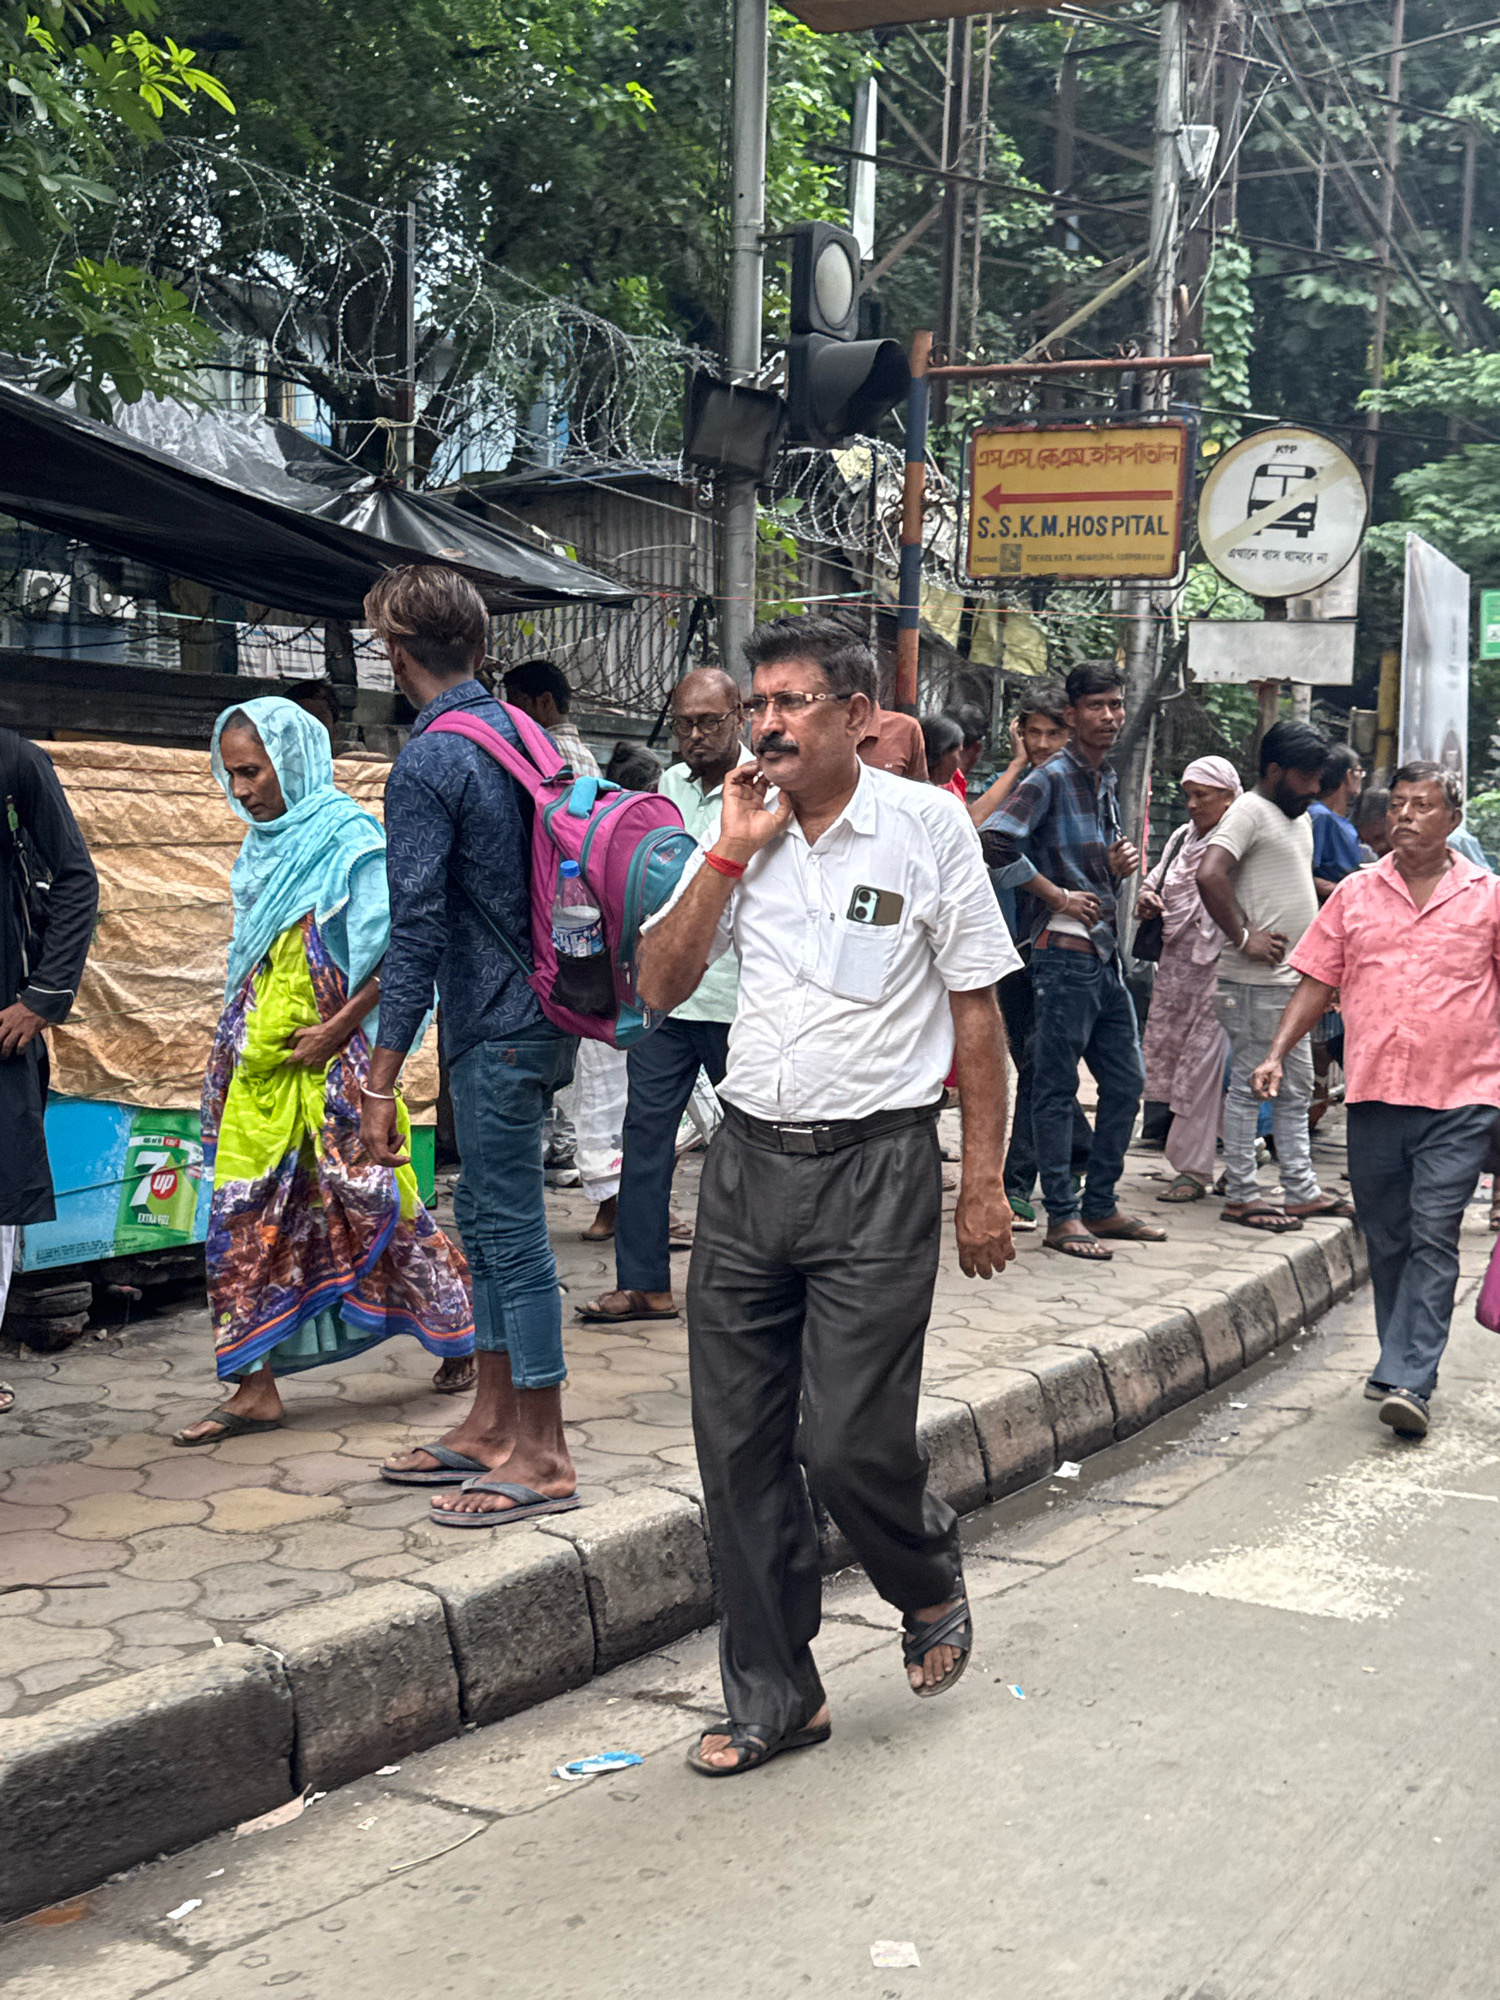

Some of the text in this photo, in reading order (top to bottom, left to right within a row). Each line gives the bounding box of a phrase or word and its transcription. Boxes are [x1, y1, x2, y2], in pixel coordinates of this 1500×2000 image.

[1275, 444, 1298, 454] KTP
[1227, 548, 1259, 561] এখানে
[1262, 550, 1281, 561] বাস
[1315, 552, 1329, 564] না
